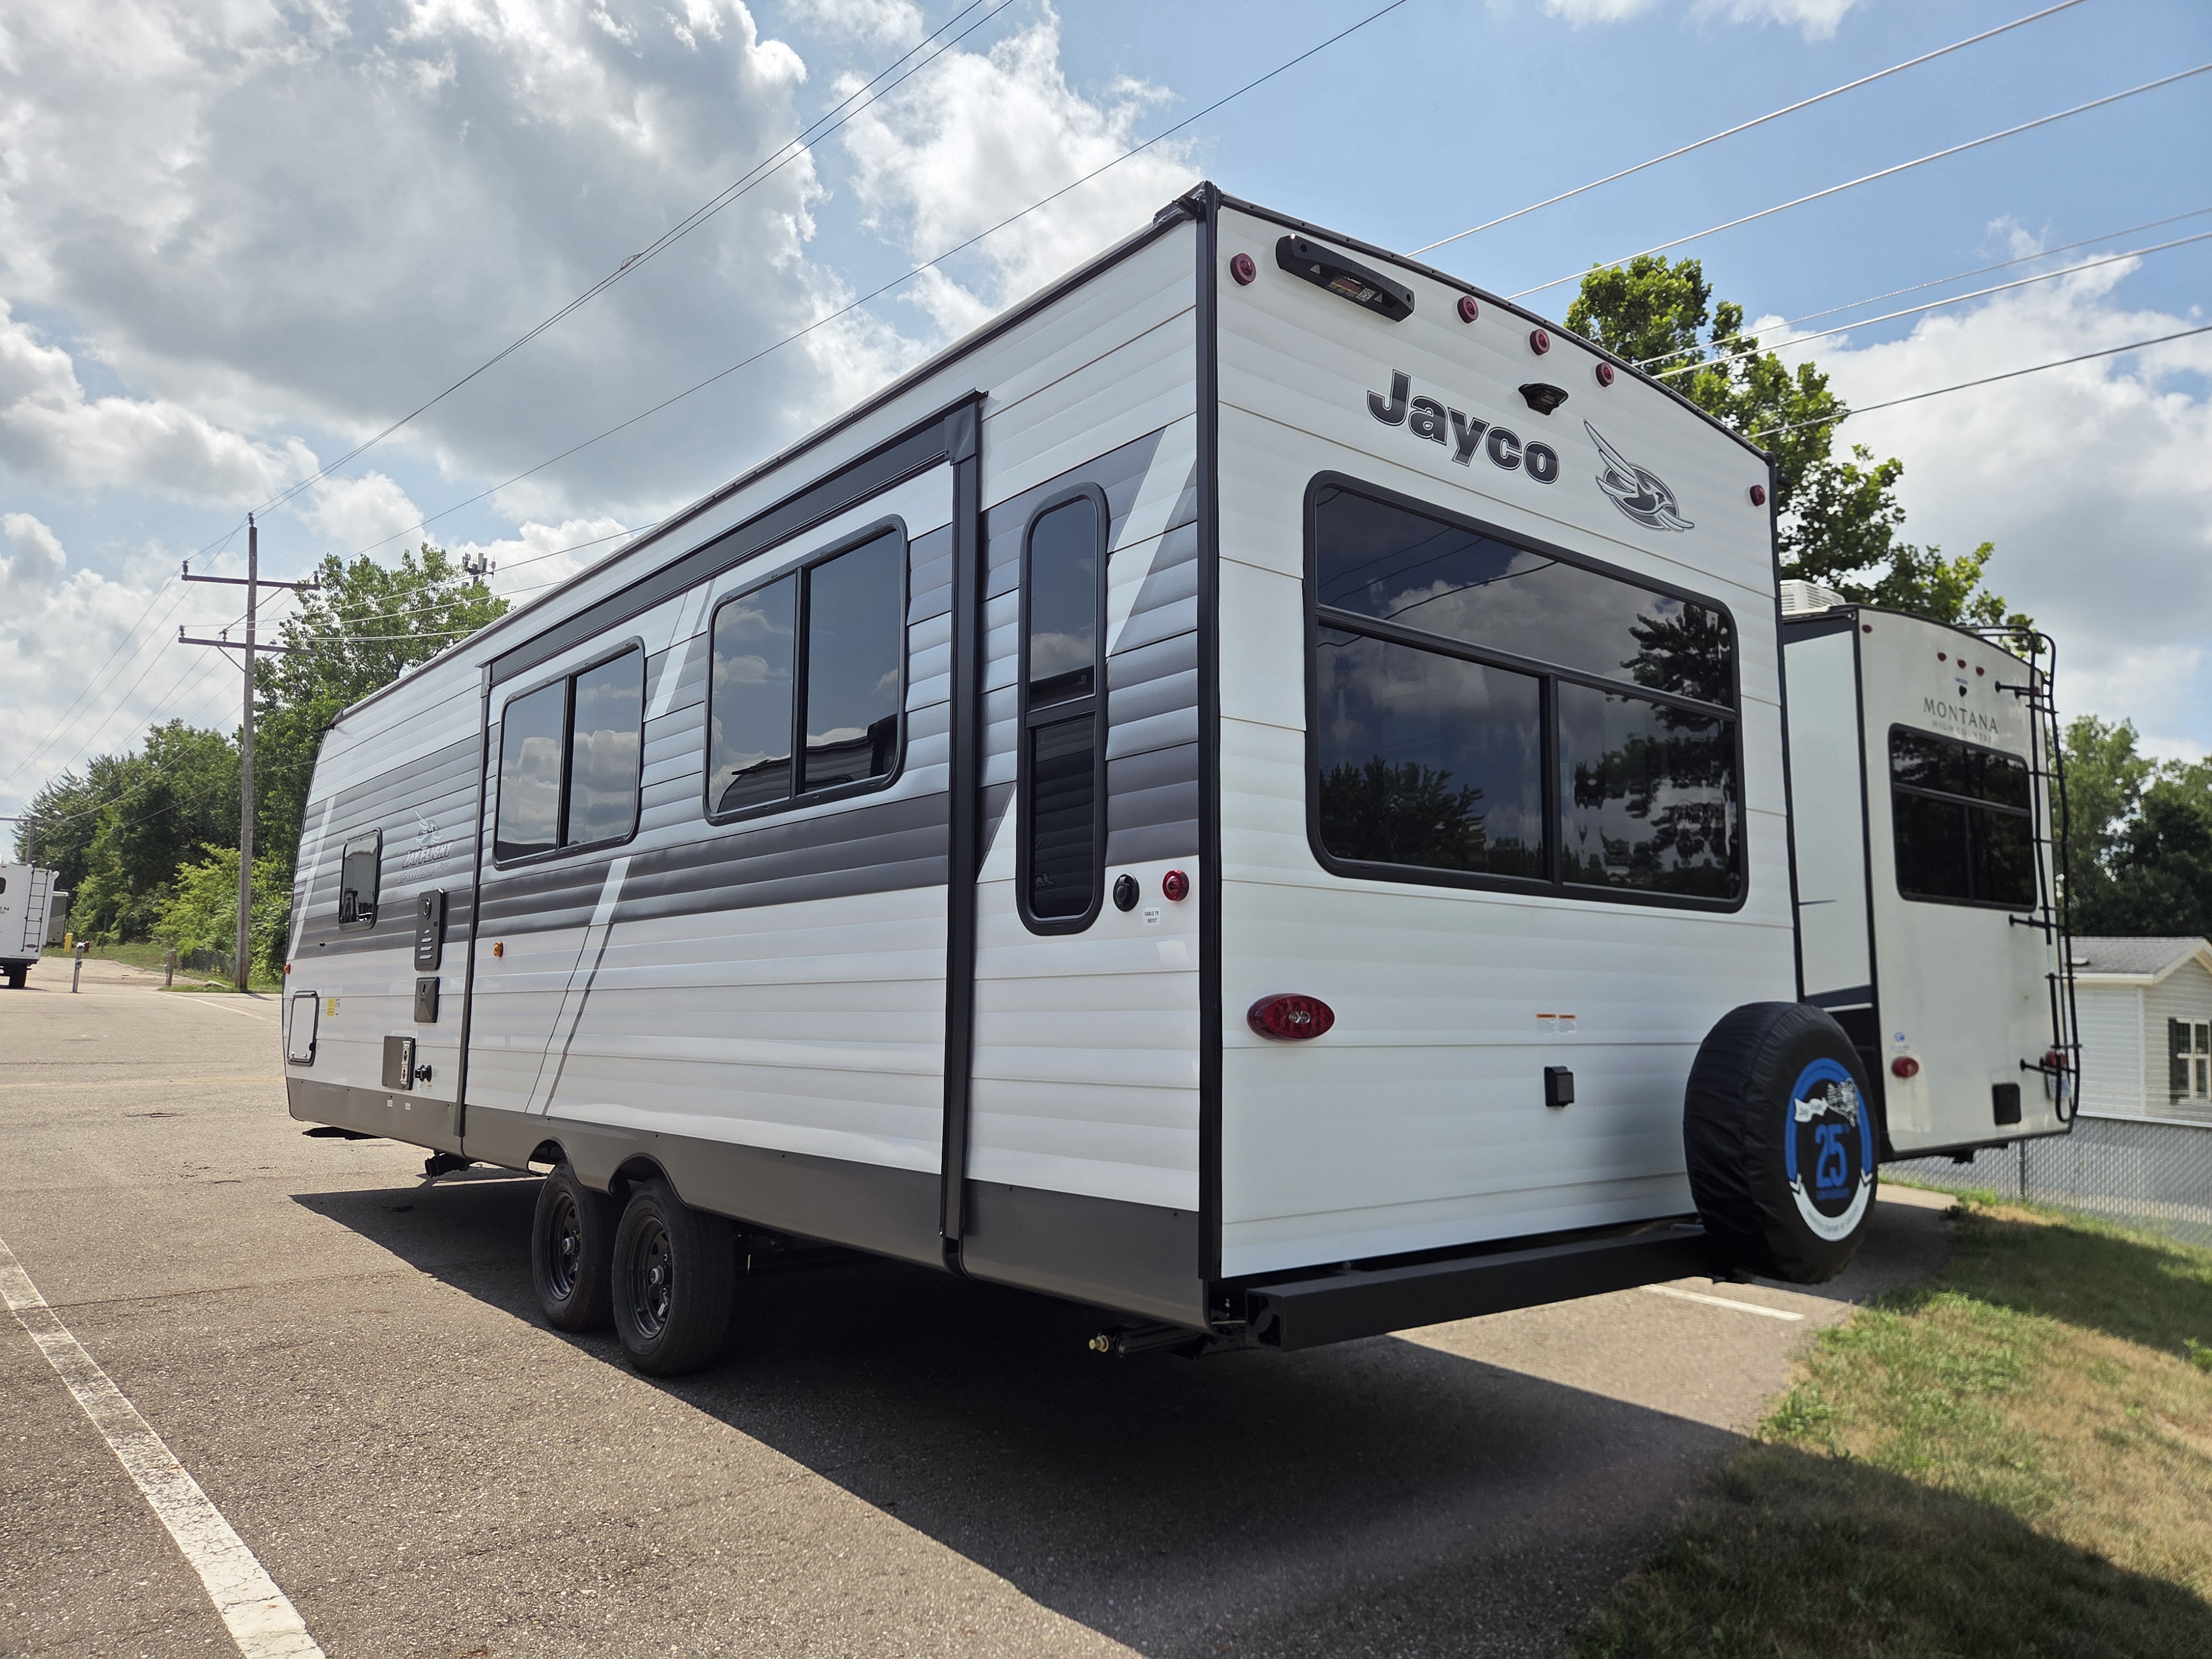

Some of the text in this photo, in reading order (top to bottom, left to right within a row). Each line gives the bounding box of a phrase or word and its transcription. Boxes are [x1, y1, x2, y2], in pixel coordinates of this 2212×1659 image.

[1367, 369, 1559, 484] Jayco
[1923, 697, 1998, 734] MONTANA
[402, 849, 421, 868] JAY
[419, 840, 453, 864] FLIGHT
